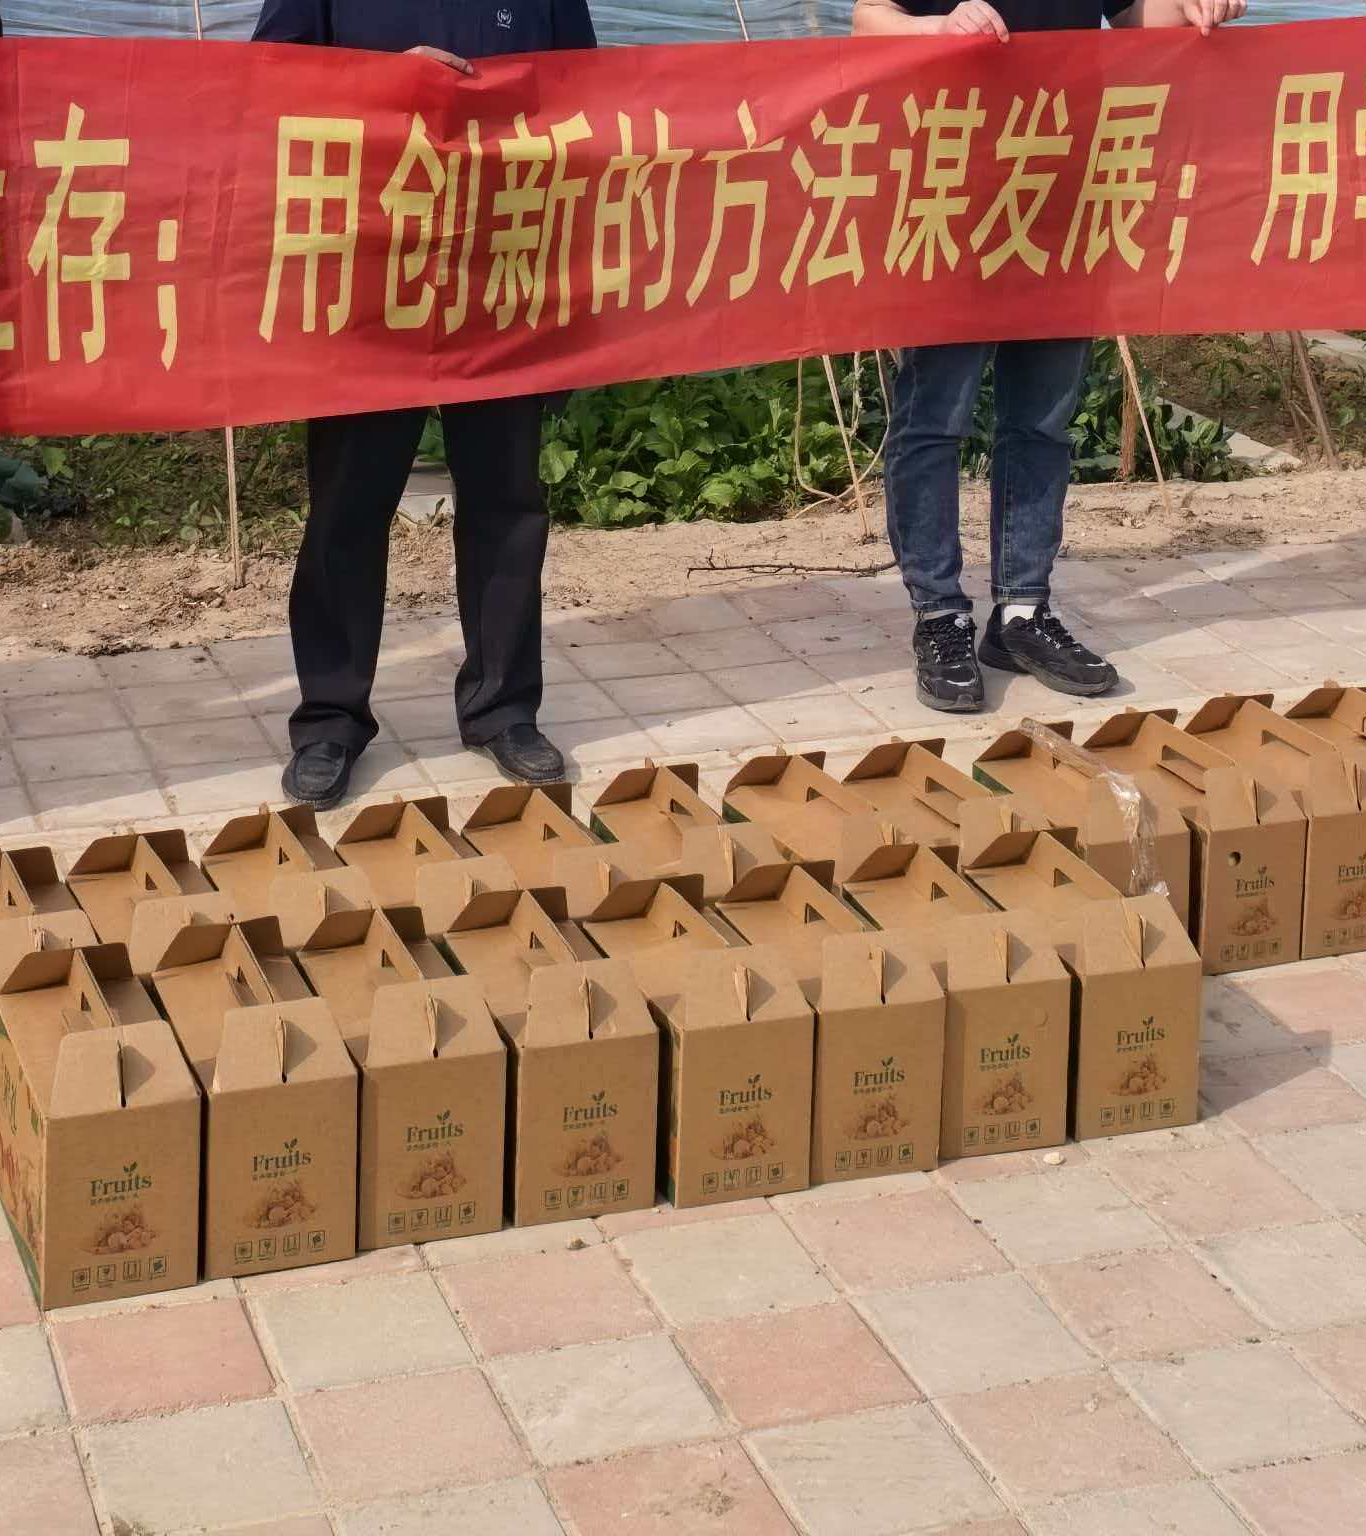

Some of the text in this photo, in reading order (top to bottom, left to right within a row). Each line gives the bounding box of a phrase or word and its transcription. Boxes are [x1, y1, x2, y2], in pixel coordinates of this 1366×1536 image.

[1235, 874, 1276, 892] Fruits
[1116, 1025, 1165, 1046] Fruits
[980, 1043, 1031, 1064] Fruits
[854, 1066, 906, 1088] Fruits
[719, 1084, 773, 1106] Fruits
[563, 1103, 619, 1123] Fruits
[406, 1121, 464, 1143] Fruits
[252, 1149, 312, 1172] Fruits
[90, 1173, 153, 1197] Fruits
